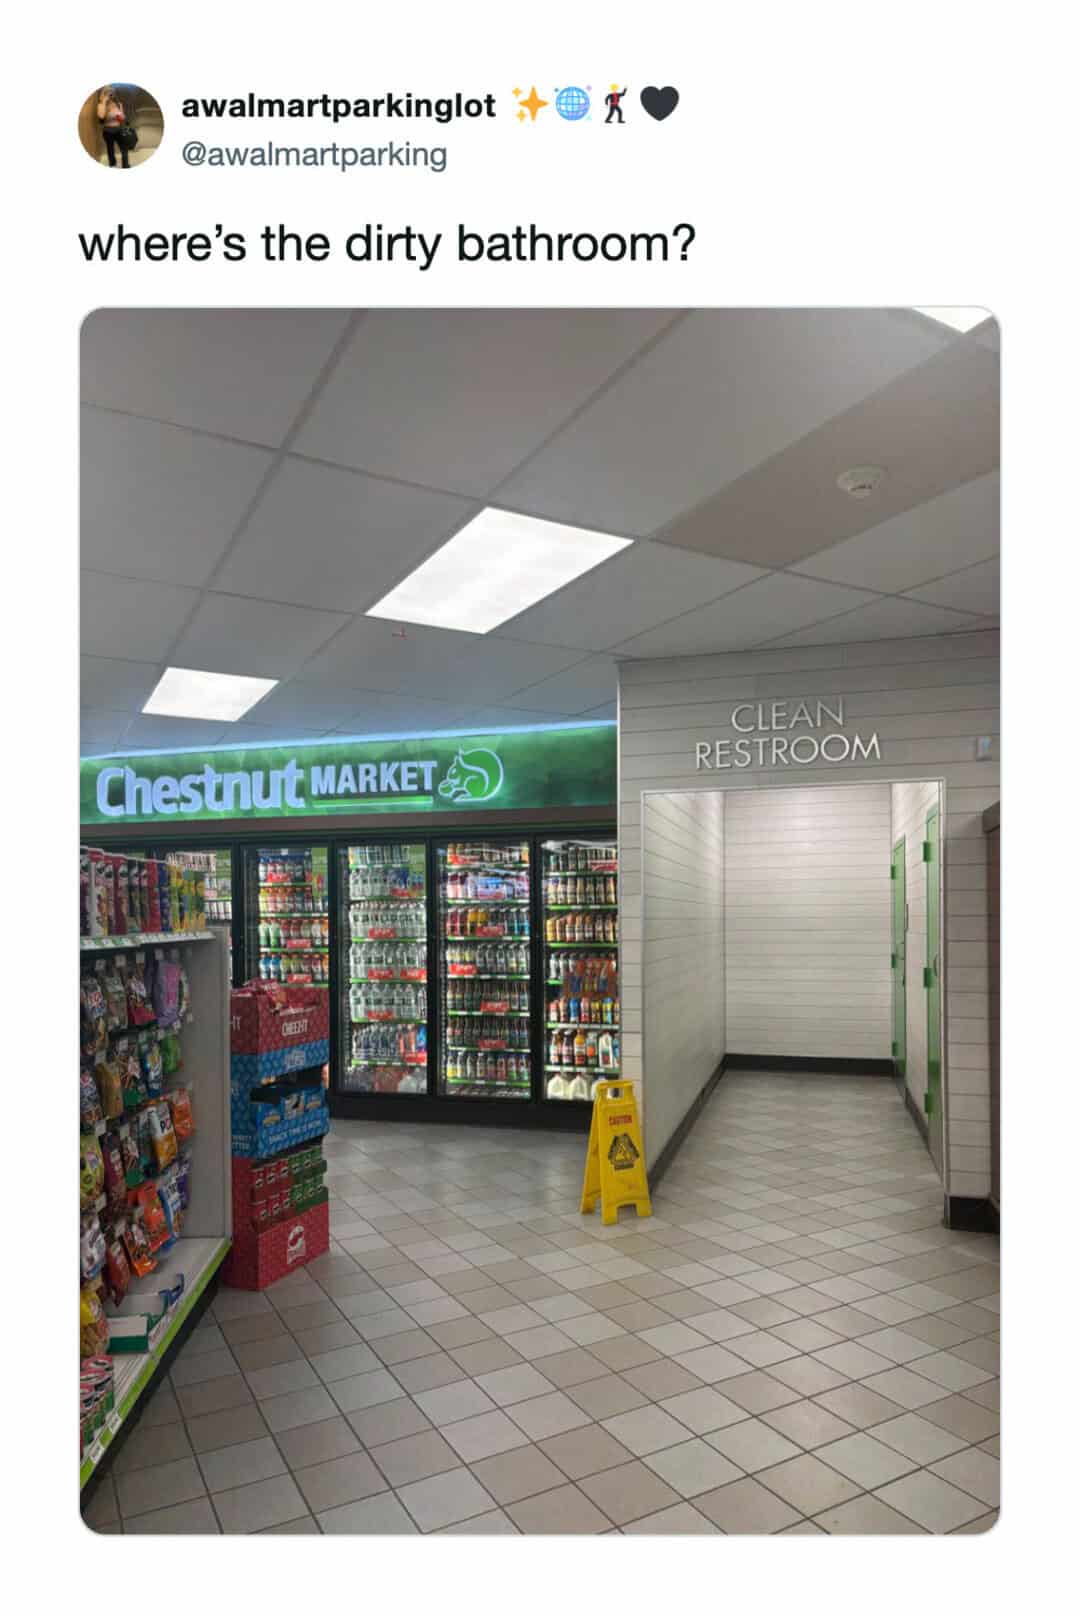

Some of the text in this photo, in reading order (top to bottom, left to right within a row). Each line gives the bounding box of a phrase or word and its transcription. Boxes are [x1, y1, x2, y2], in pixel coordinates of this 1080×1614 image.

[731, 699, 845, 732] CLEAN
[695, 733, 881, 769] RESTROOM
[96, 759, 438, 817] Chestnut MARKET
